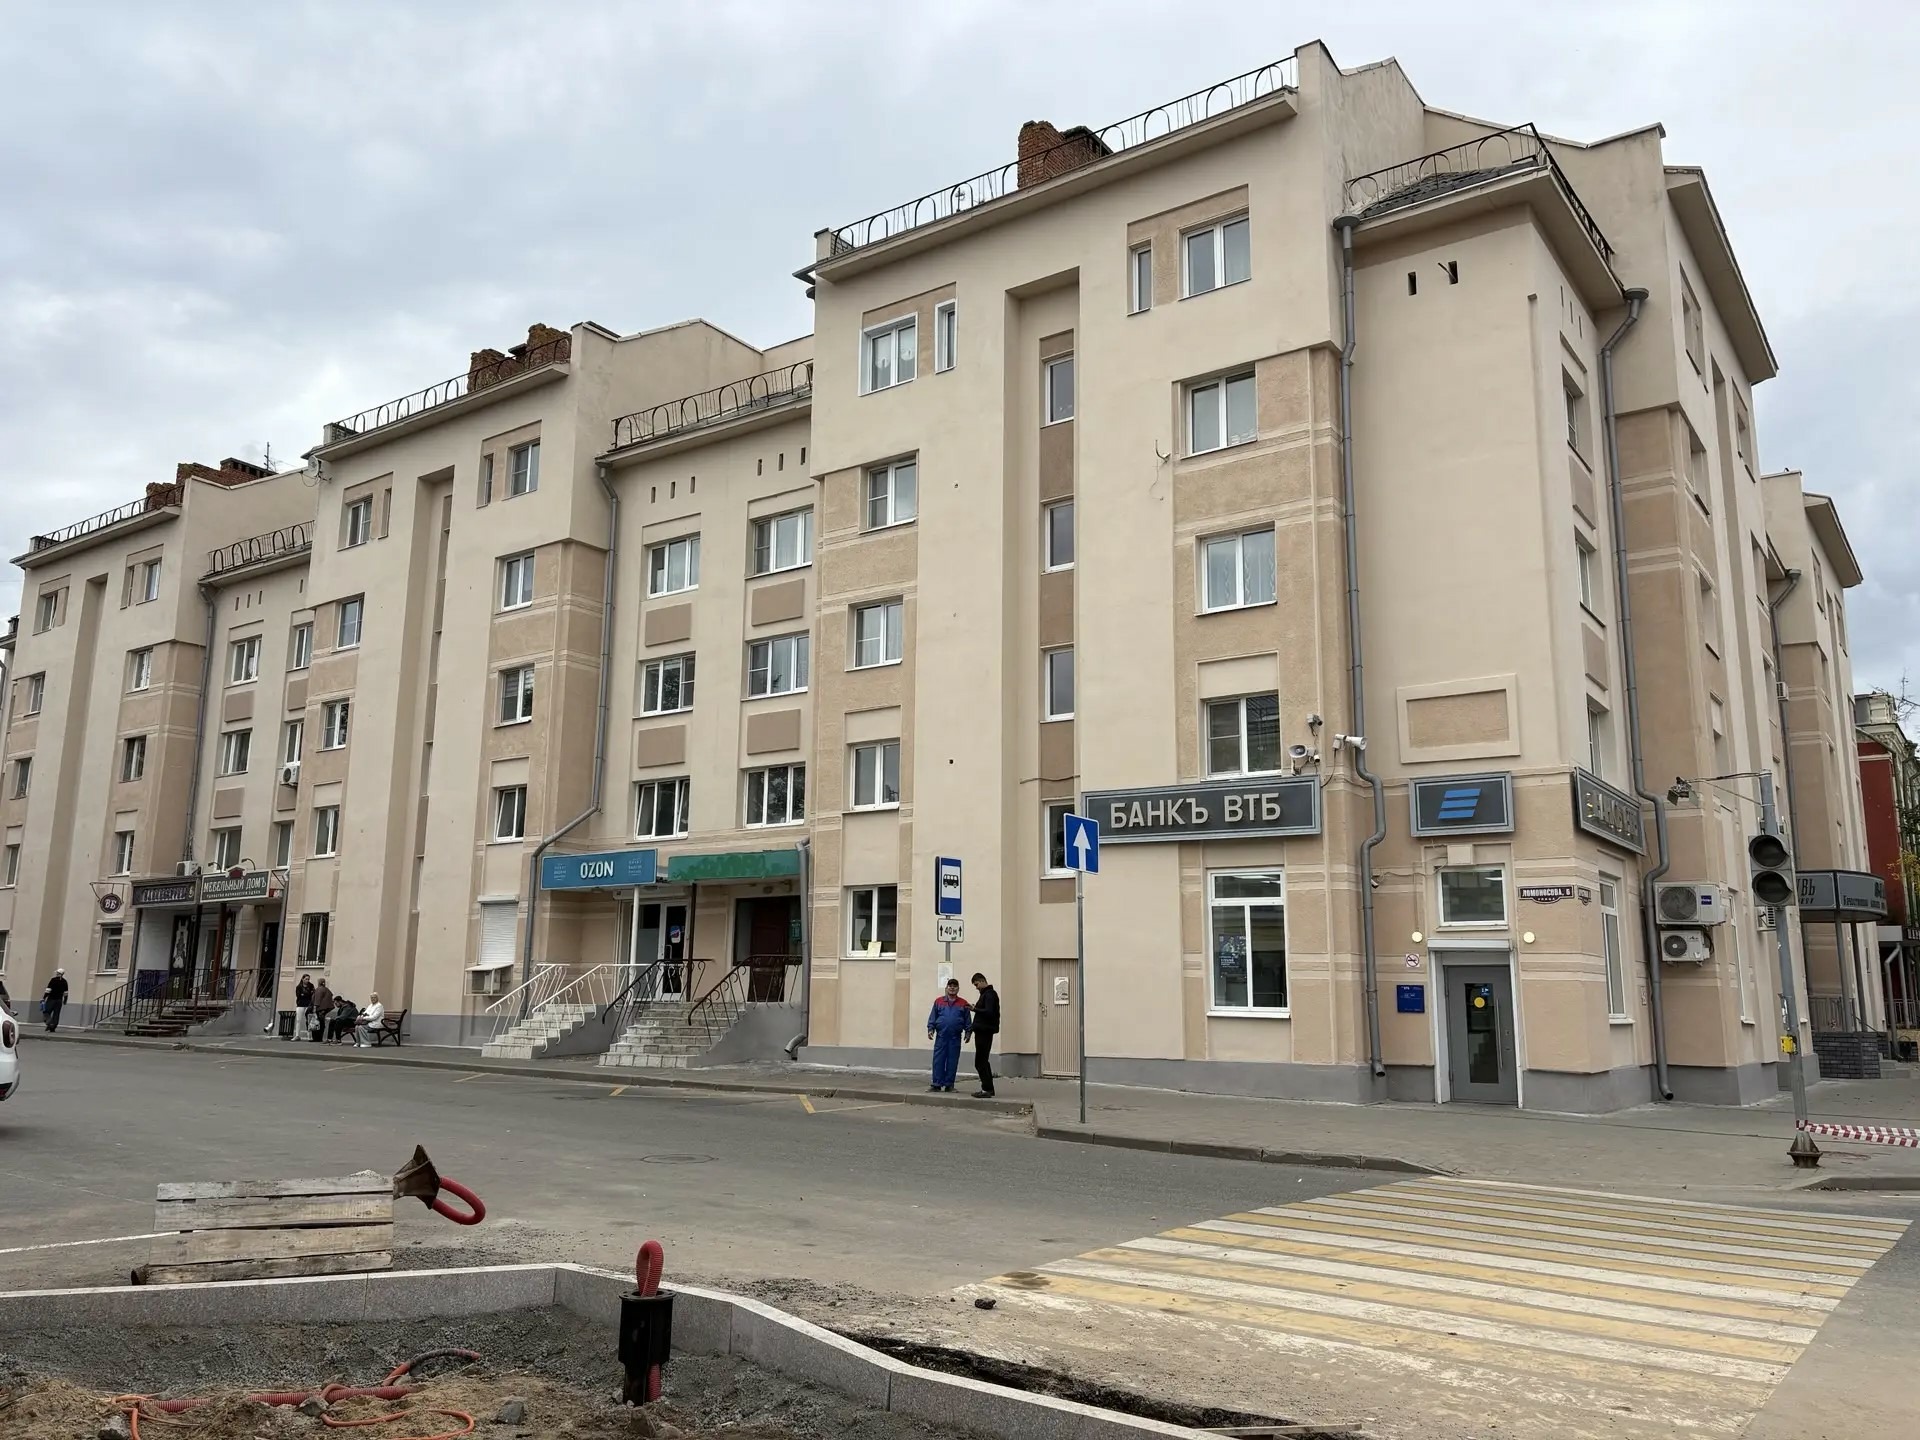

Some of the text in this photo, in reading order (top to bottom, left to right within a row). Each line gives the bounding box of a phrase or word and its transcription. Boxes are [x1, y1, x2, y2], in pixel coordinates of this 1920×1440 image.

[1110, 792, 1281, 829] БАНКЪ ВТБ
[580, 861, 614, 879] OZON
[203, 877, 267, 893] МЕБЕЛЬНЫЙ ДОМЪ
